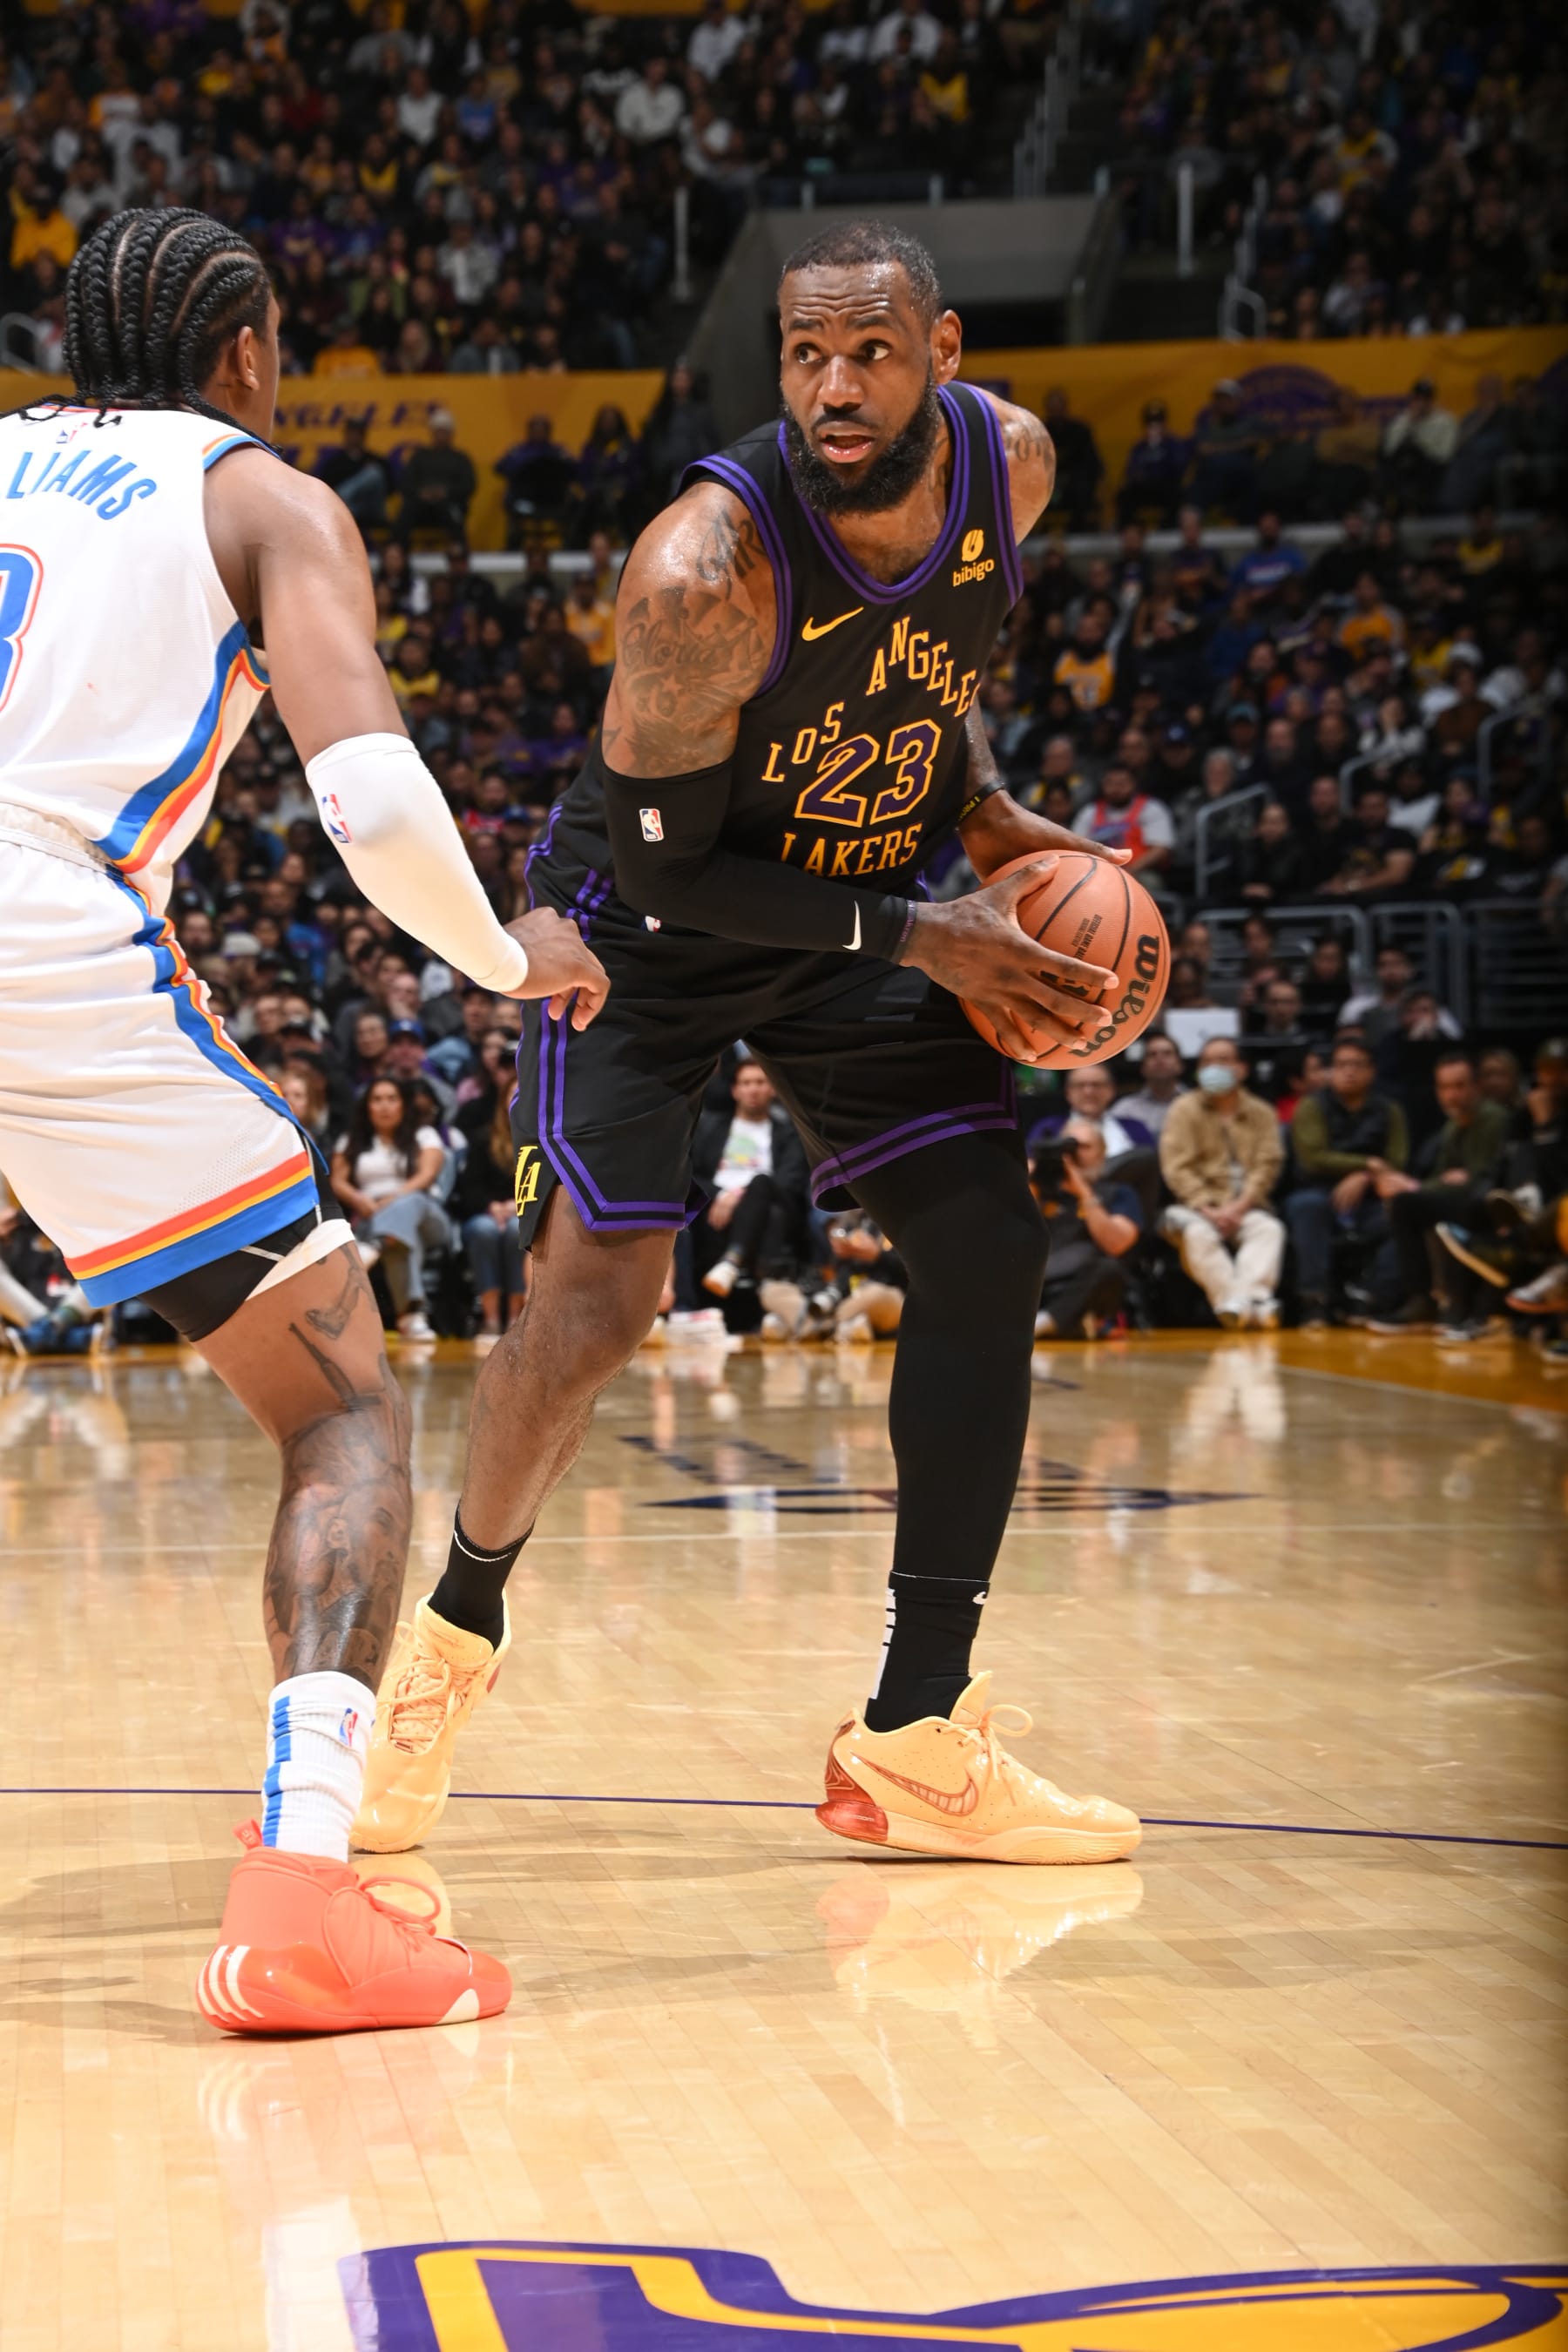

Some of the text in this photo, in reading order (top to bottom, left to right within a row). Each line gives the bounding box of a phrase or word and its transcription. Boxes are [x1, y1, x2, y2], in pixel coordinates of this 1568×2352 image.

[953, 558, 995, 587] bibigo
[761, 616, 981, 782] LOS ANGELE
[794, 719, 943, 828] 23
[781, 823, 923, 878] LAKERS
